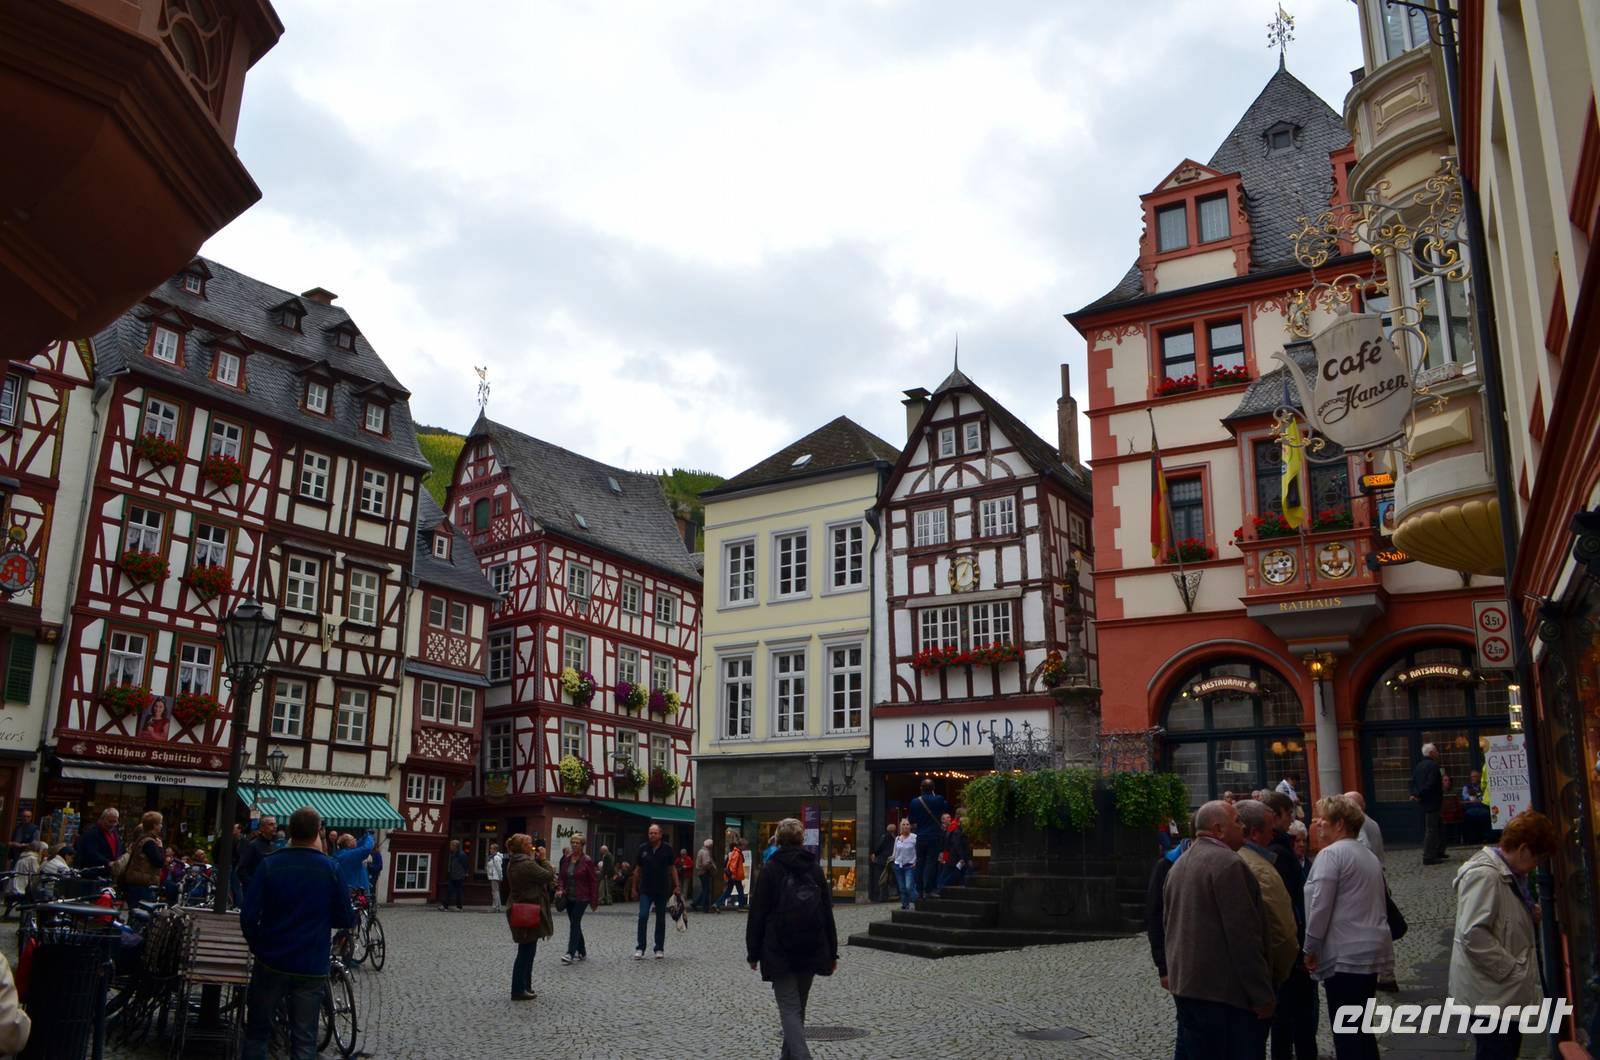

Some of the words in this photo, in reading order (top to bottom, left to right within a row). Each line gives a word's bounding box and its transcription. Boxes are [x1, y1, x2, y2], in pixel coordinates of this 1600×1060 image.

[1323, 374, 1408, 425] Hansen
[1280, 597, 1341, 611] RATHAUS
[1409, 665, 1459, 679] RATSKELLER
[1201, 678, 1248, 691] RESTAURANT
[904, 718, 1013, 748] KRONSER
[95, 744, 147, 759] Weinhaus
[1488, 749, 1527, 770] CAFÉ
[114, 773, 147, 782] eigenes
[154, 775, 187, 785] Weingut
[1489, 775, 1529, 787] BESTEN
